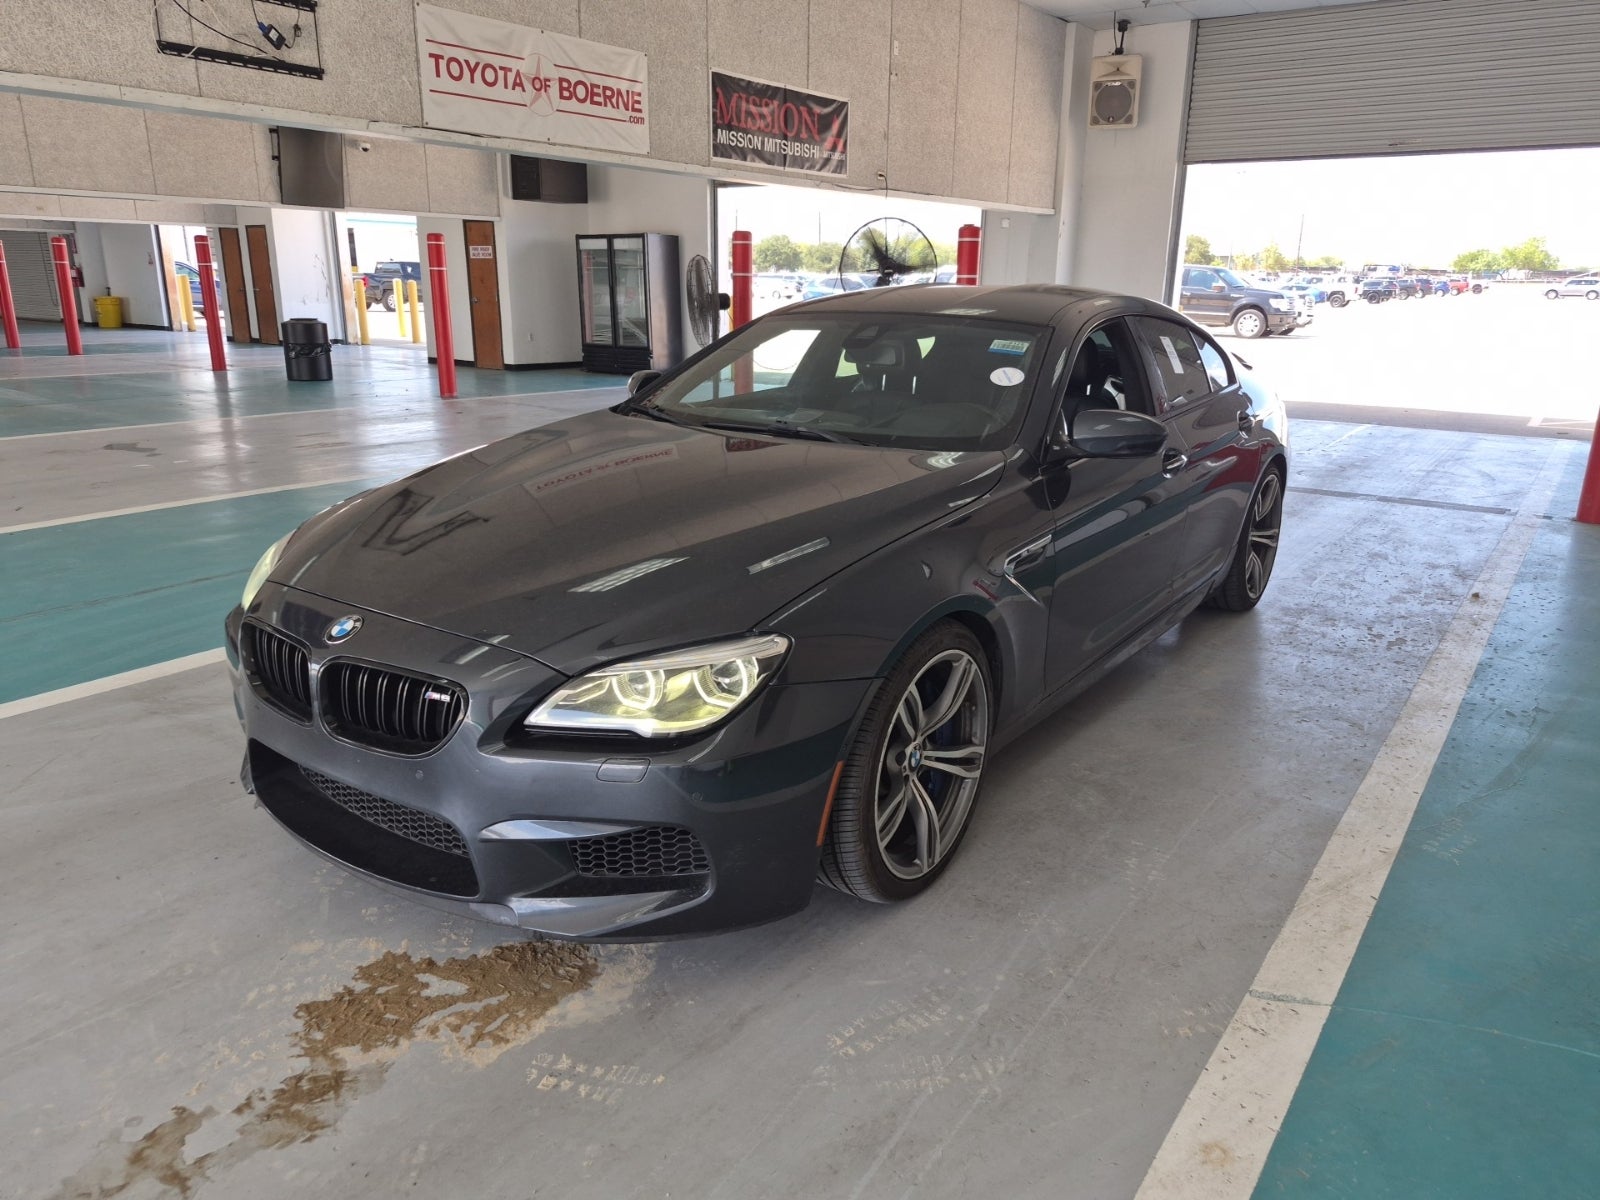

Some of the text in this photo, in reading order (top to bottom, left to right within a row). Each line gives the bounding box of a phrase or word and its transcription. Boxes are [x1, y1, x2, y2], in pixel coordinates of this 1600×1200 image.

[428, 53, 643, 113] TOYOTA OF BOERNE
[716, 87, 820, 141] MISSION
[717, 129, 820, 158] MISSION MITSUBISHI
